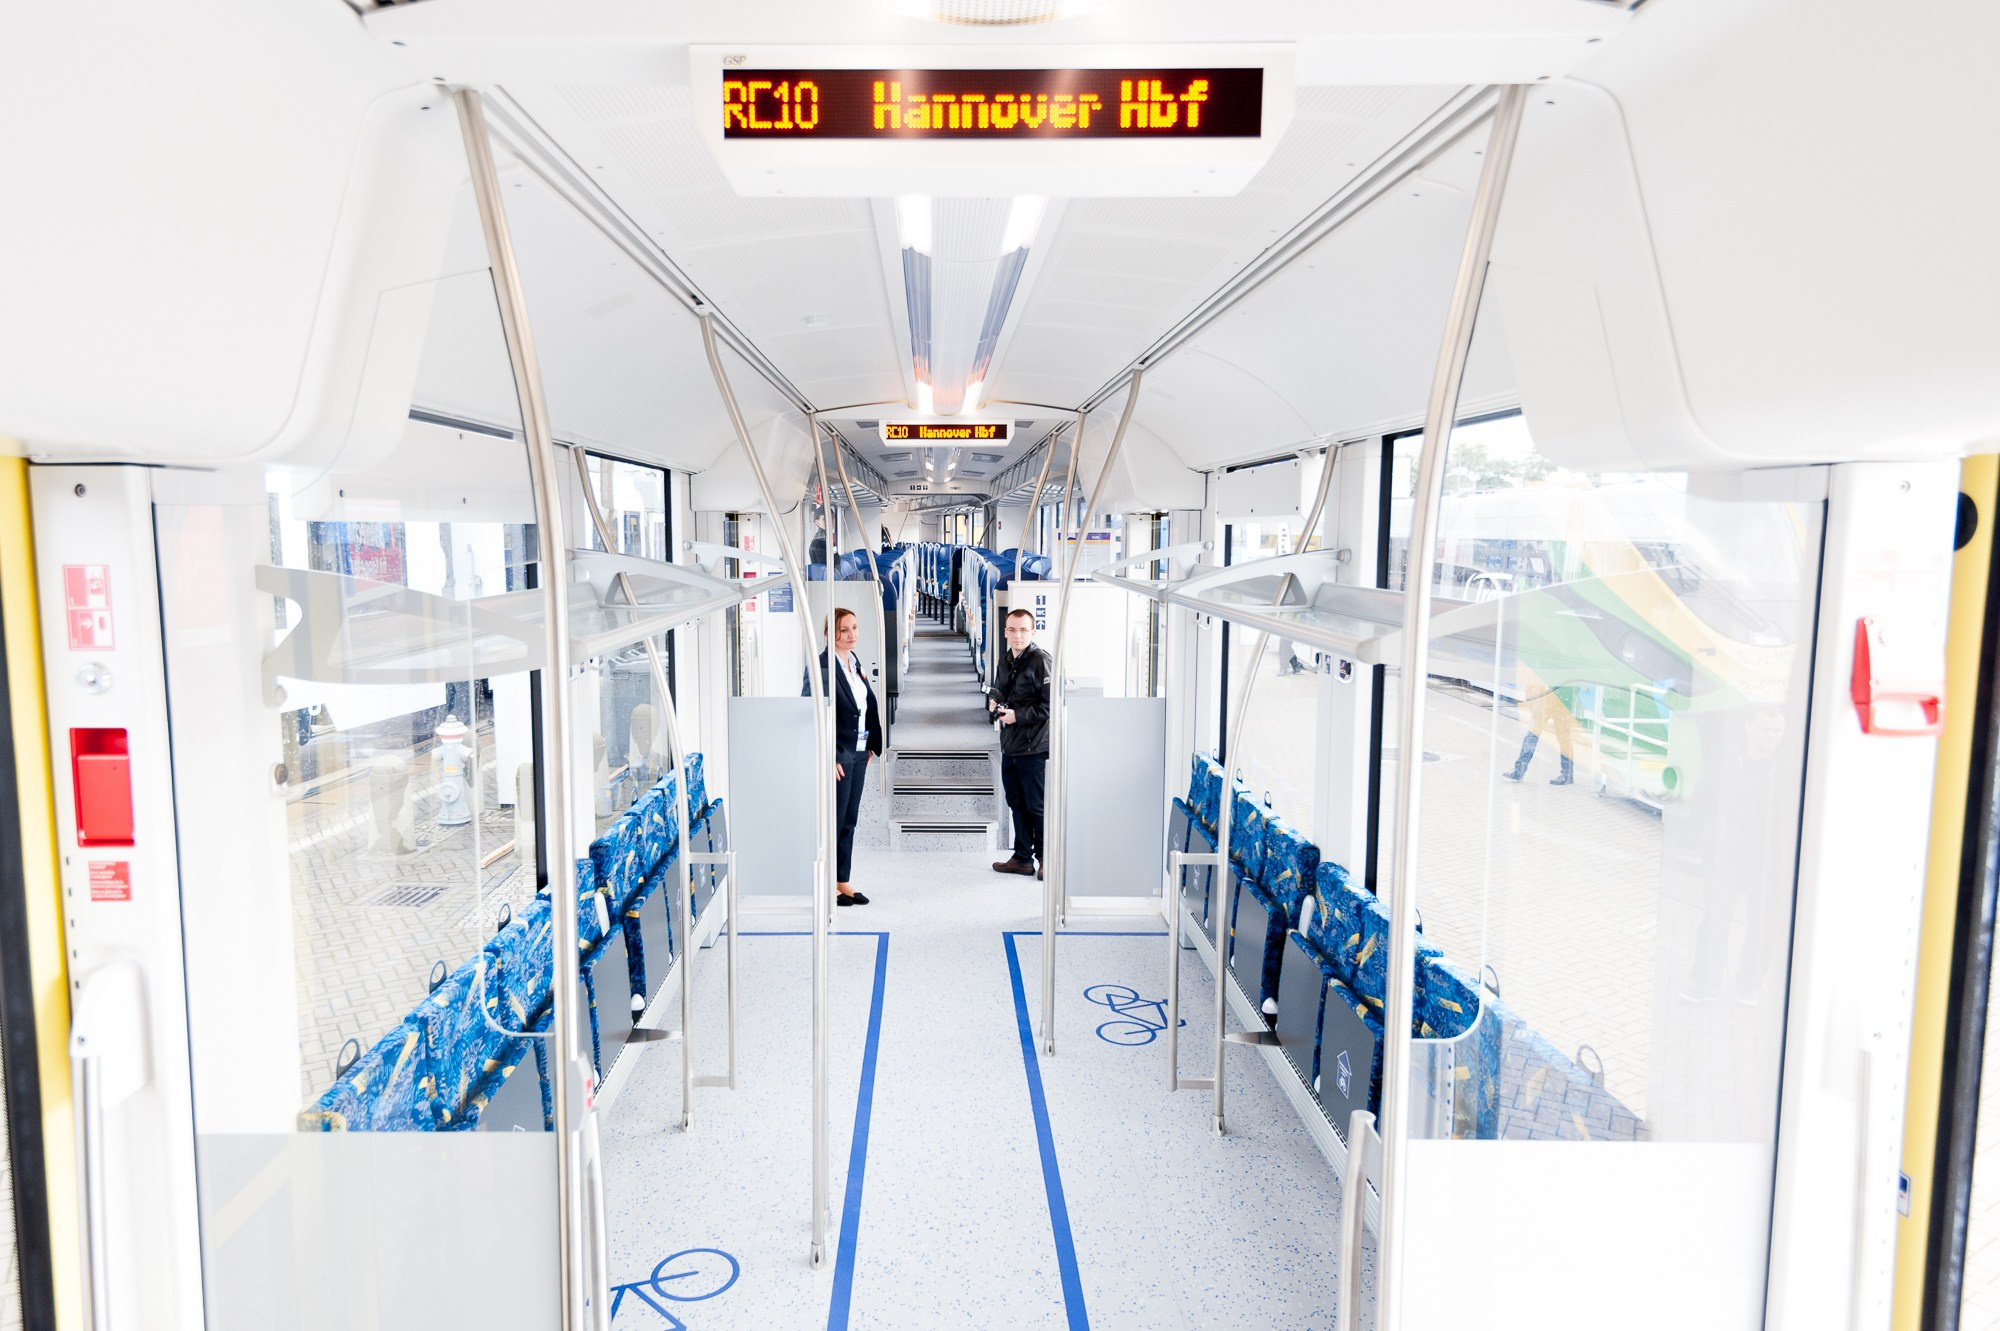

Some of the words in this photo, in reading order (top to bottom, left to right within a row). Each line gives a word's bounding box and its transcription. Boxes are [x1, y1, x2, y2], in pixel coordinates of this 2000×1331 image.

[723, 55, 746, 65] GSP
[723, 81, 819, 129] RC10
[873, 81, 1103, 129] Hannover
[1119, 80, 1210, 129] Hbf
[886, 425, 909, 438] RC10
[920, 426, 972, 438] Hannover
[975, 425, 996, 438] Hbf
